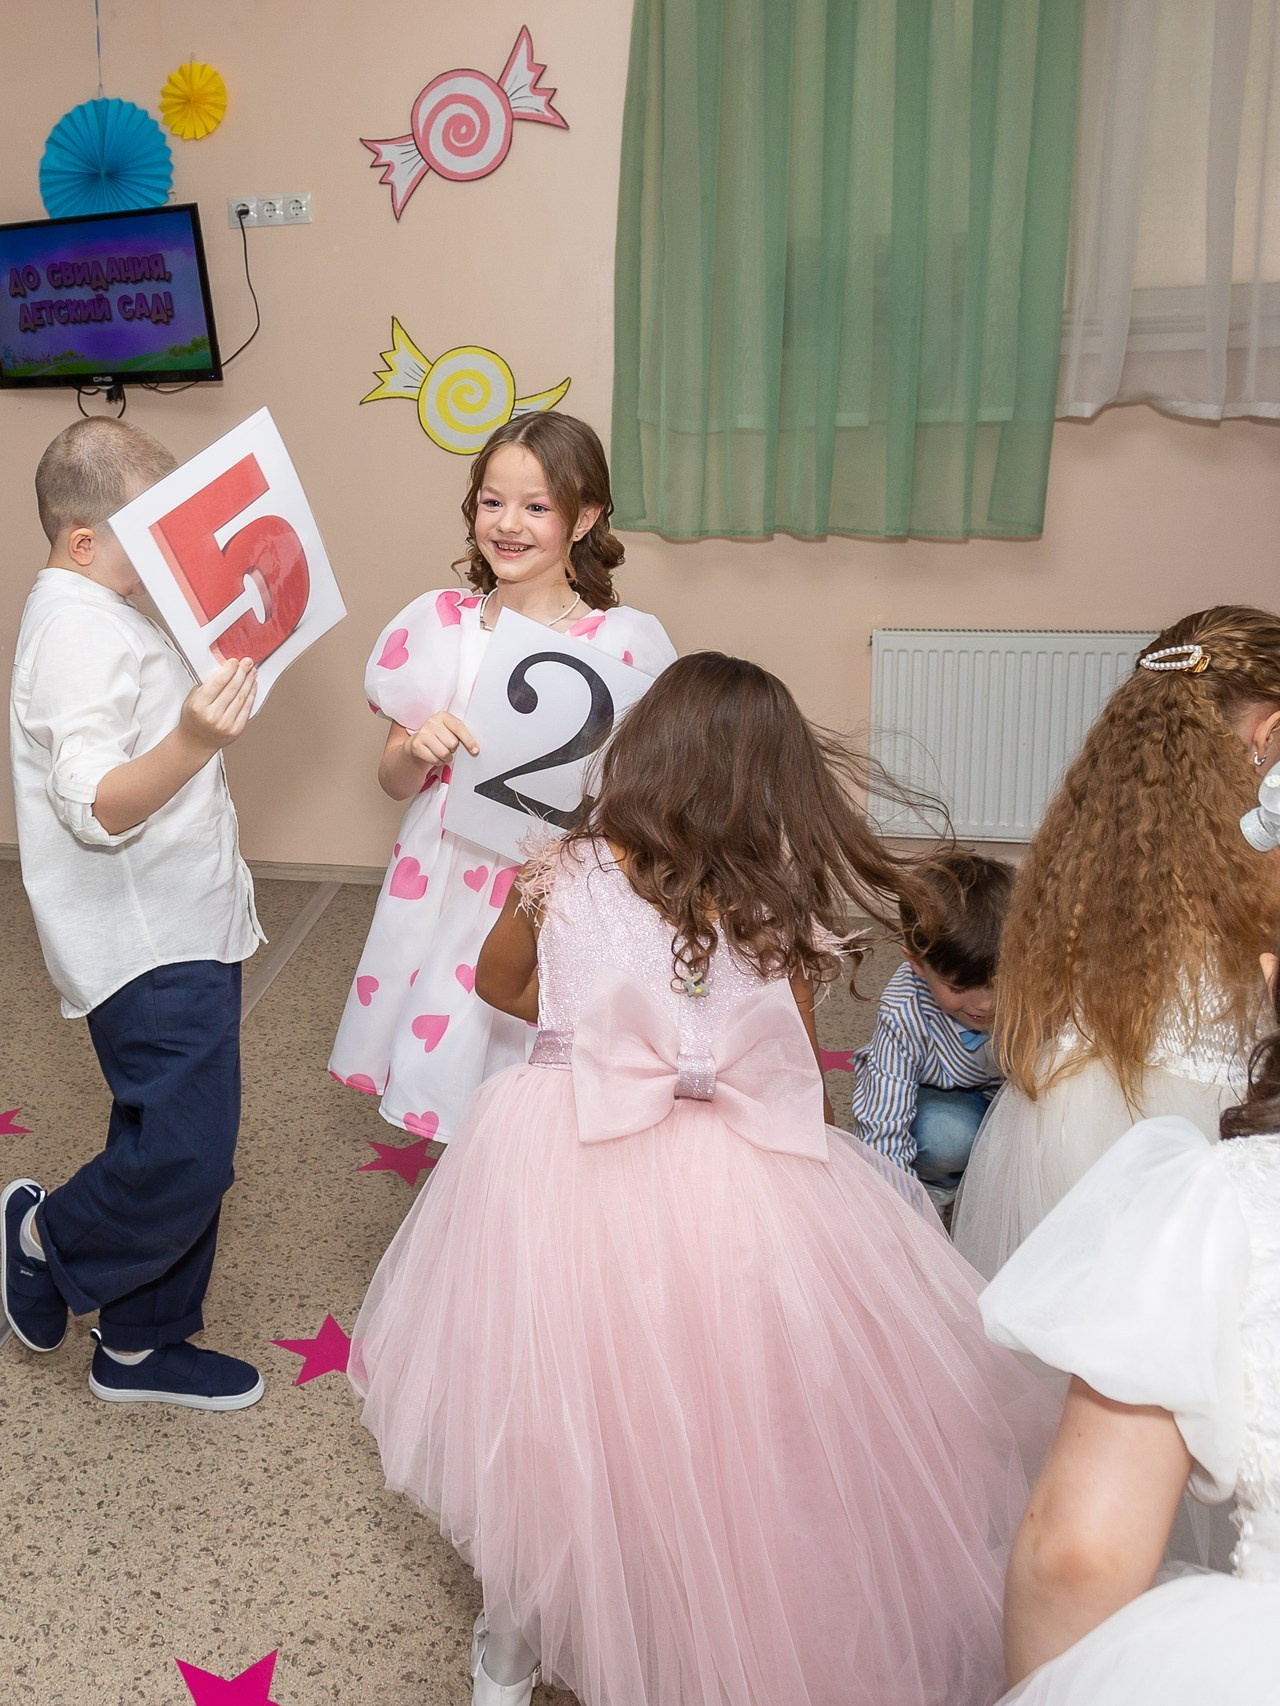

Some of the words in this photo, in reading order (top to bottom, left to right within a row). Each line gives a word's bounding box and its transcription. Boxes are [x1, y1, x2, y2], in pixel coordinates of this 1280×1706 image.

[9, 265, 40, 297] ДО
[46, 253, 172, 291] СВИДАНИЯ,
[19, 294, 112, 332] ДЕТСКИЙ
[117, 291, 174, 324] САД!
[148, 452, 310, 668] 5
[474, 651, 614, 832] 2
